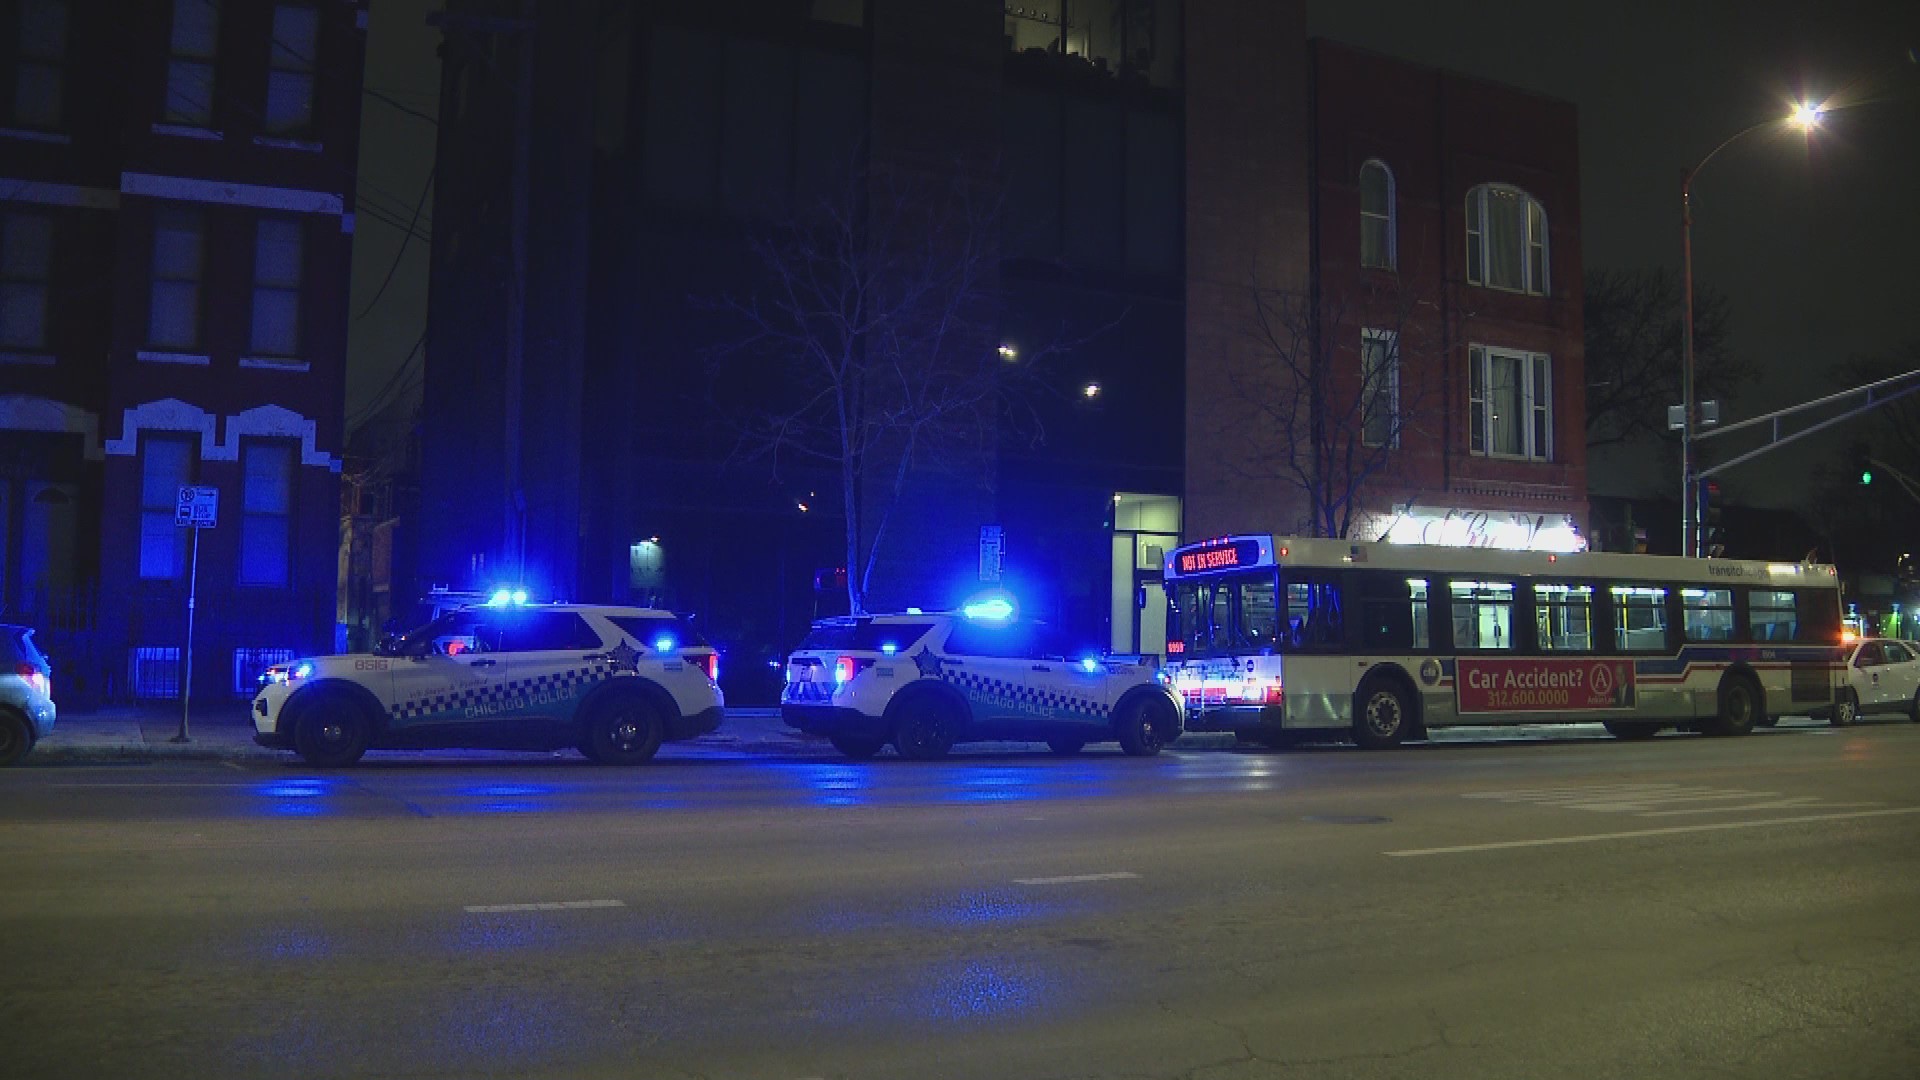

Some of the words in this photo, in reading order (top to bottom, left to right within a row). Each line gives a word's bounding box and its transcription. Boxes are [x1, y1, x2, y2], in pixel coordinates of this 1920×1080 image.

[1182, 555, 1196, 571] NOT
[1197, 553, 1206, 569] IN
[1207, 547, 1238, 568] SERVICE
[1468, 669, 1499, 689] Car
[1503, 667, 1584, 689] Accident?
[464, 697, 524, 719] CHICAGO
[530, 686, 577, 706] POLICE
[969, 689, 1014, 709] CHICAGO
[1018, 701, 1055, 718] POLICE
[1487, 690, 1569, 707] 312.600.0000
